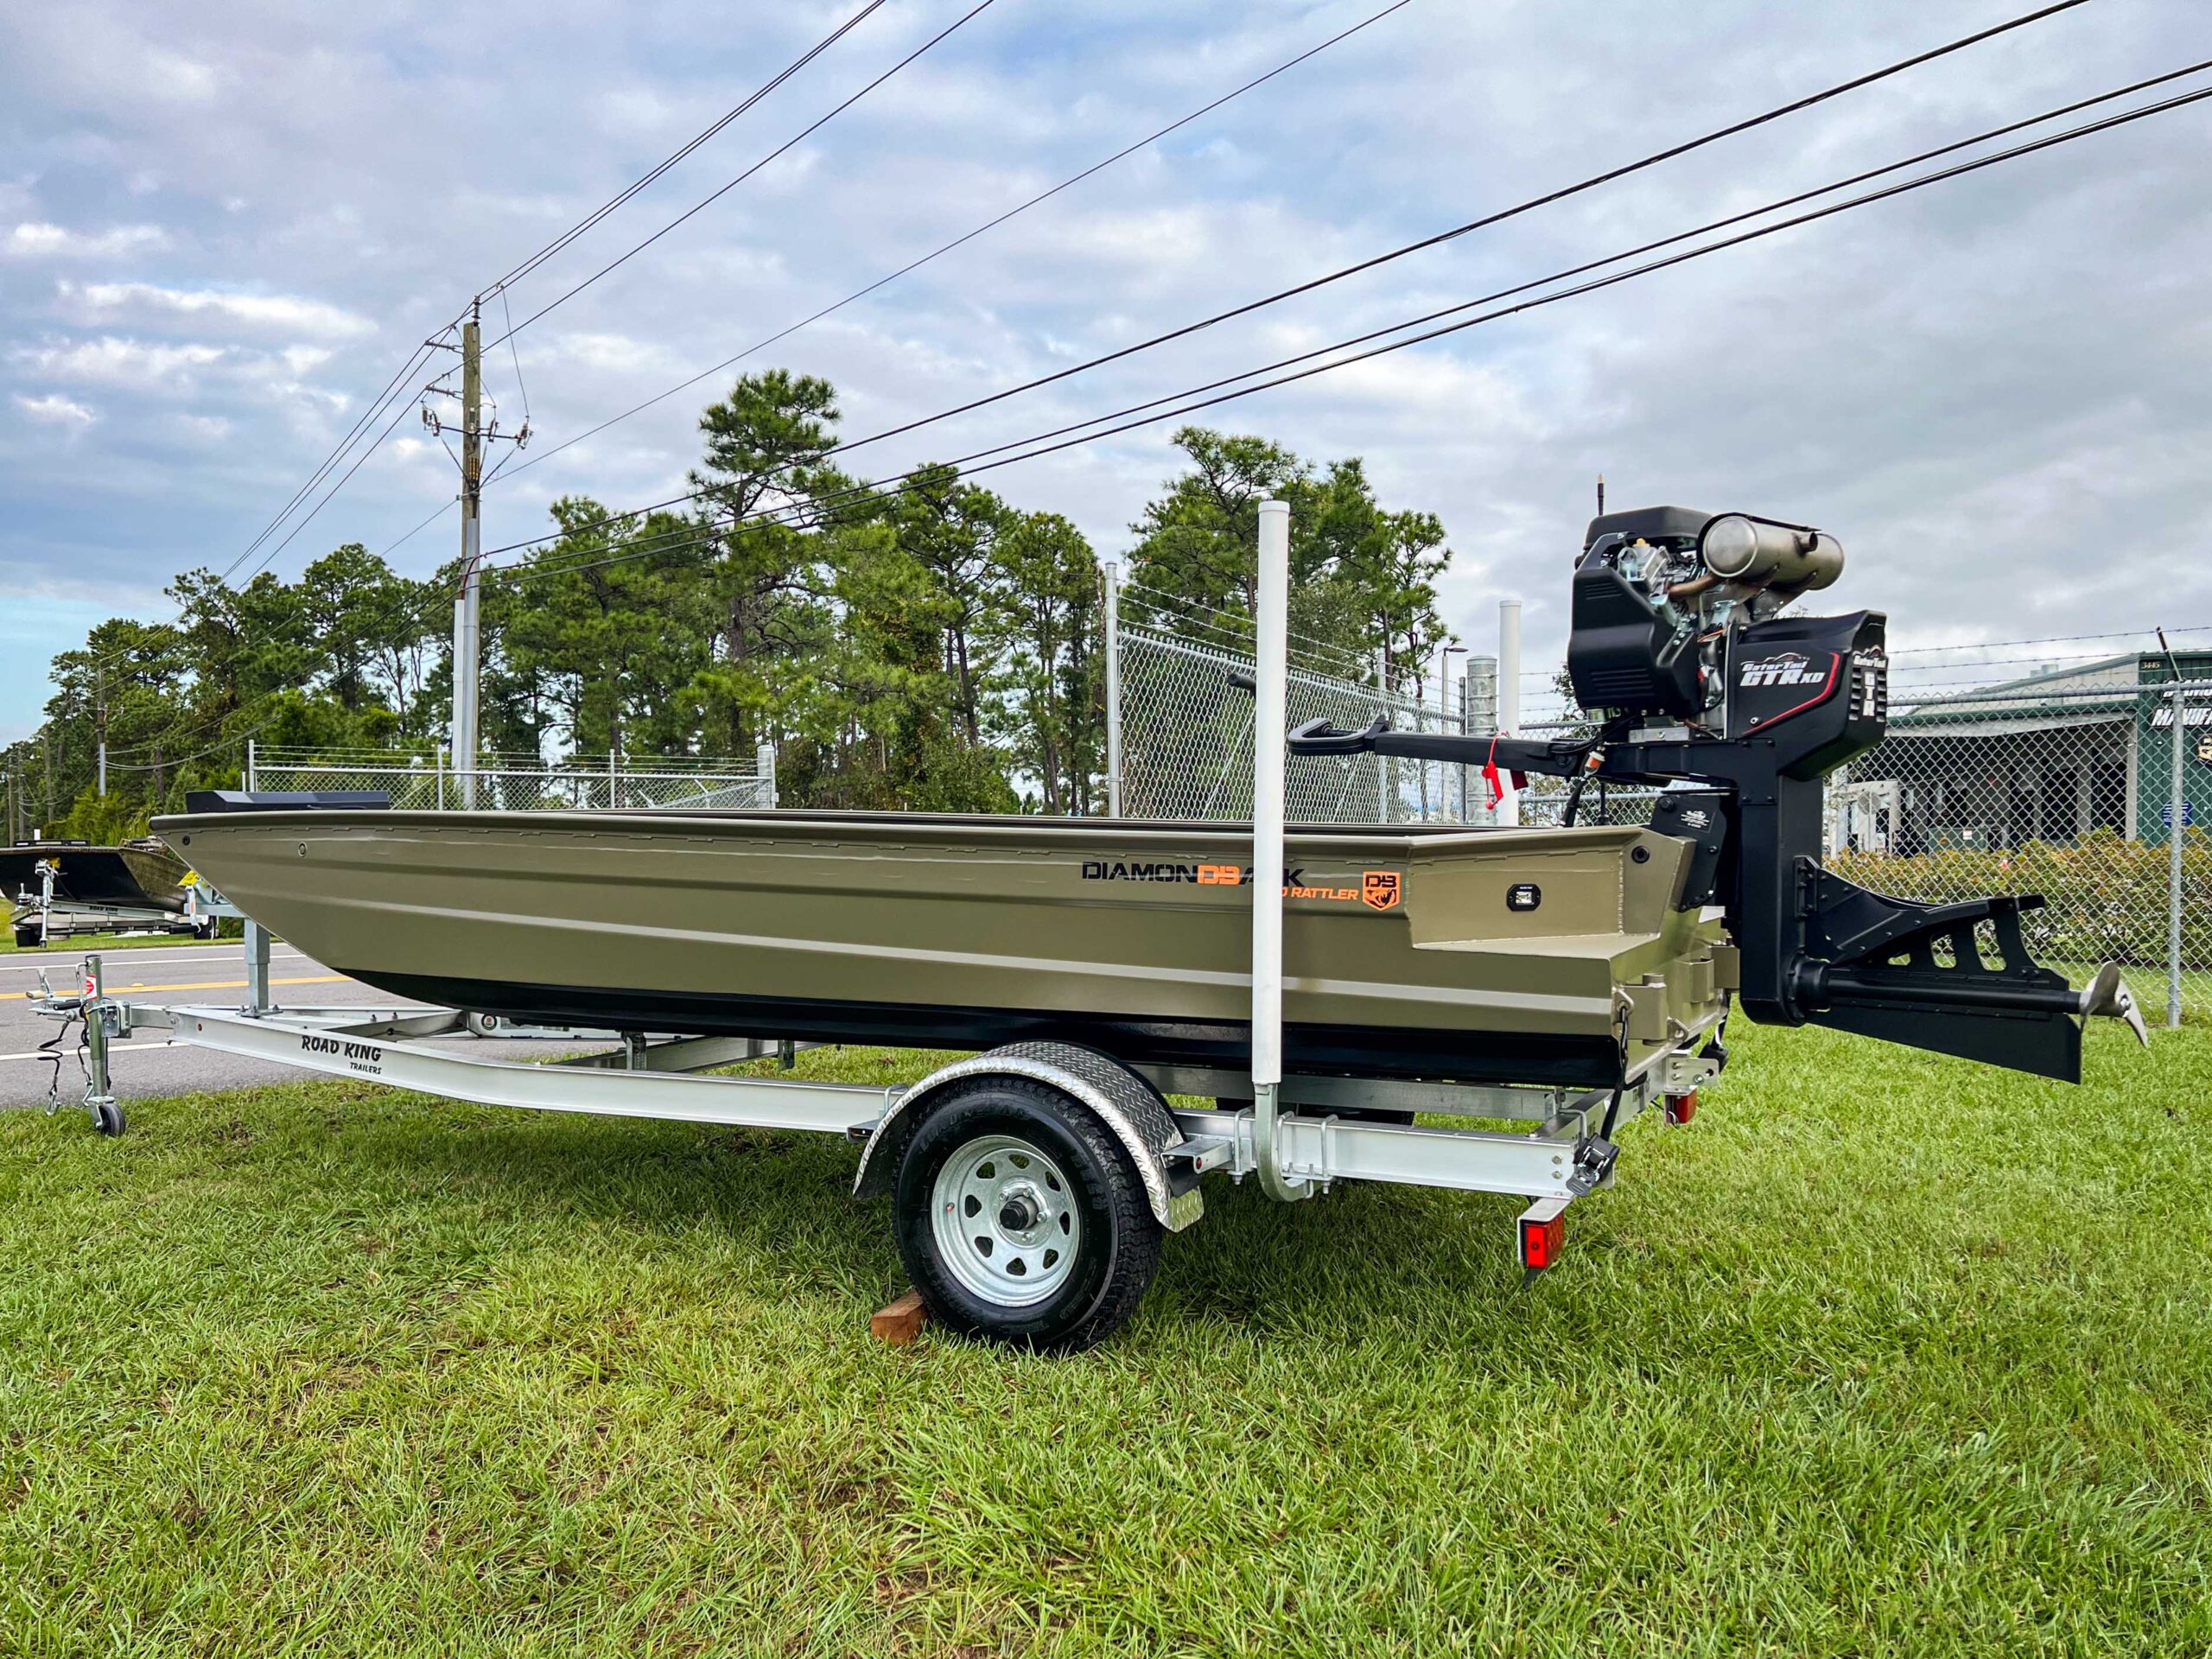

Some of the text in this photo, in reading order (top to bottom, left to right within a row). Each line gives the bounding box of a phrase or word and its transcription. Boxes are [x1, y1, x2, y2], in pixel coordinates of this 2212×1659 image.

[1082, 861, 1306, 887] DIAMONDBAK
[1365, 874, 1396, 887] DB
[1291, 887, 1359, 899] RATTLER
[302, 1035, 381, 1061] ROAD KING
[350, 1062, 382, 1074] TRAILERS
